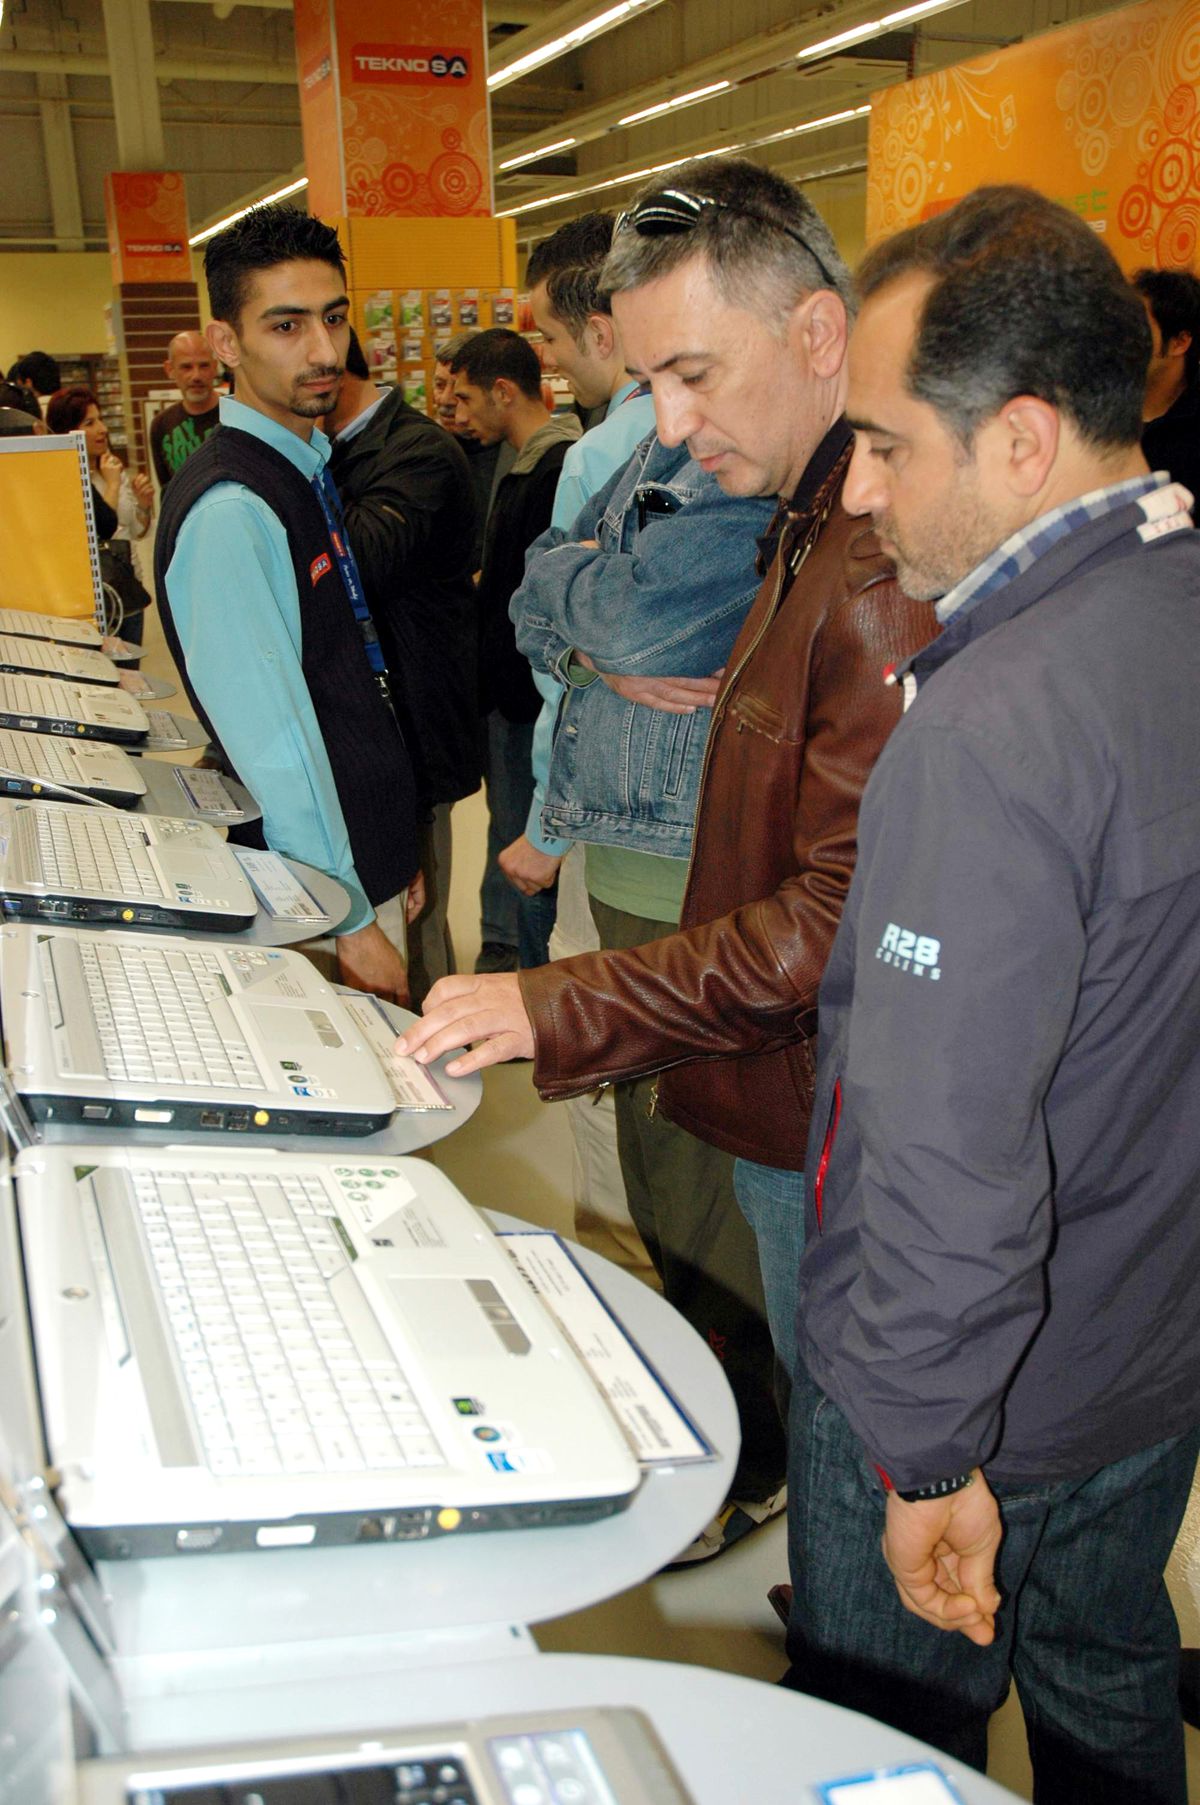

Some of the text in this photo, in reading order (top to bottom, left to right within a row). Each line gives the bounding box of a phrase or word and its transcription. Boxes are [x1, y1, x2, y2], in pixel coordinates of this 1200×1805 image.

[354, 55, 468, 78] TEKNOSA
[126, 243, 183, 253] TEKNOSA
[881, 921, 942, 967] R28
